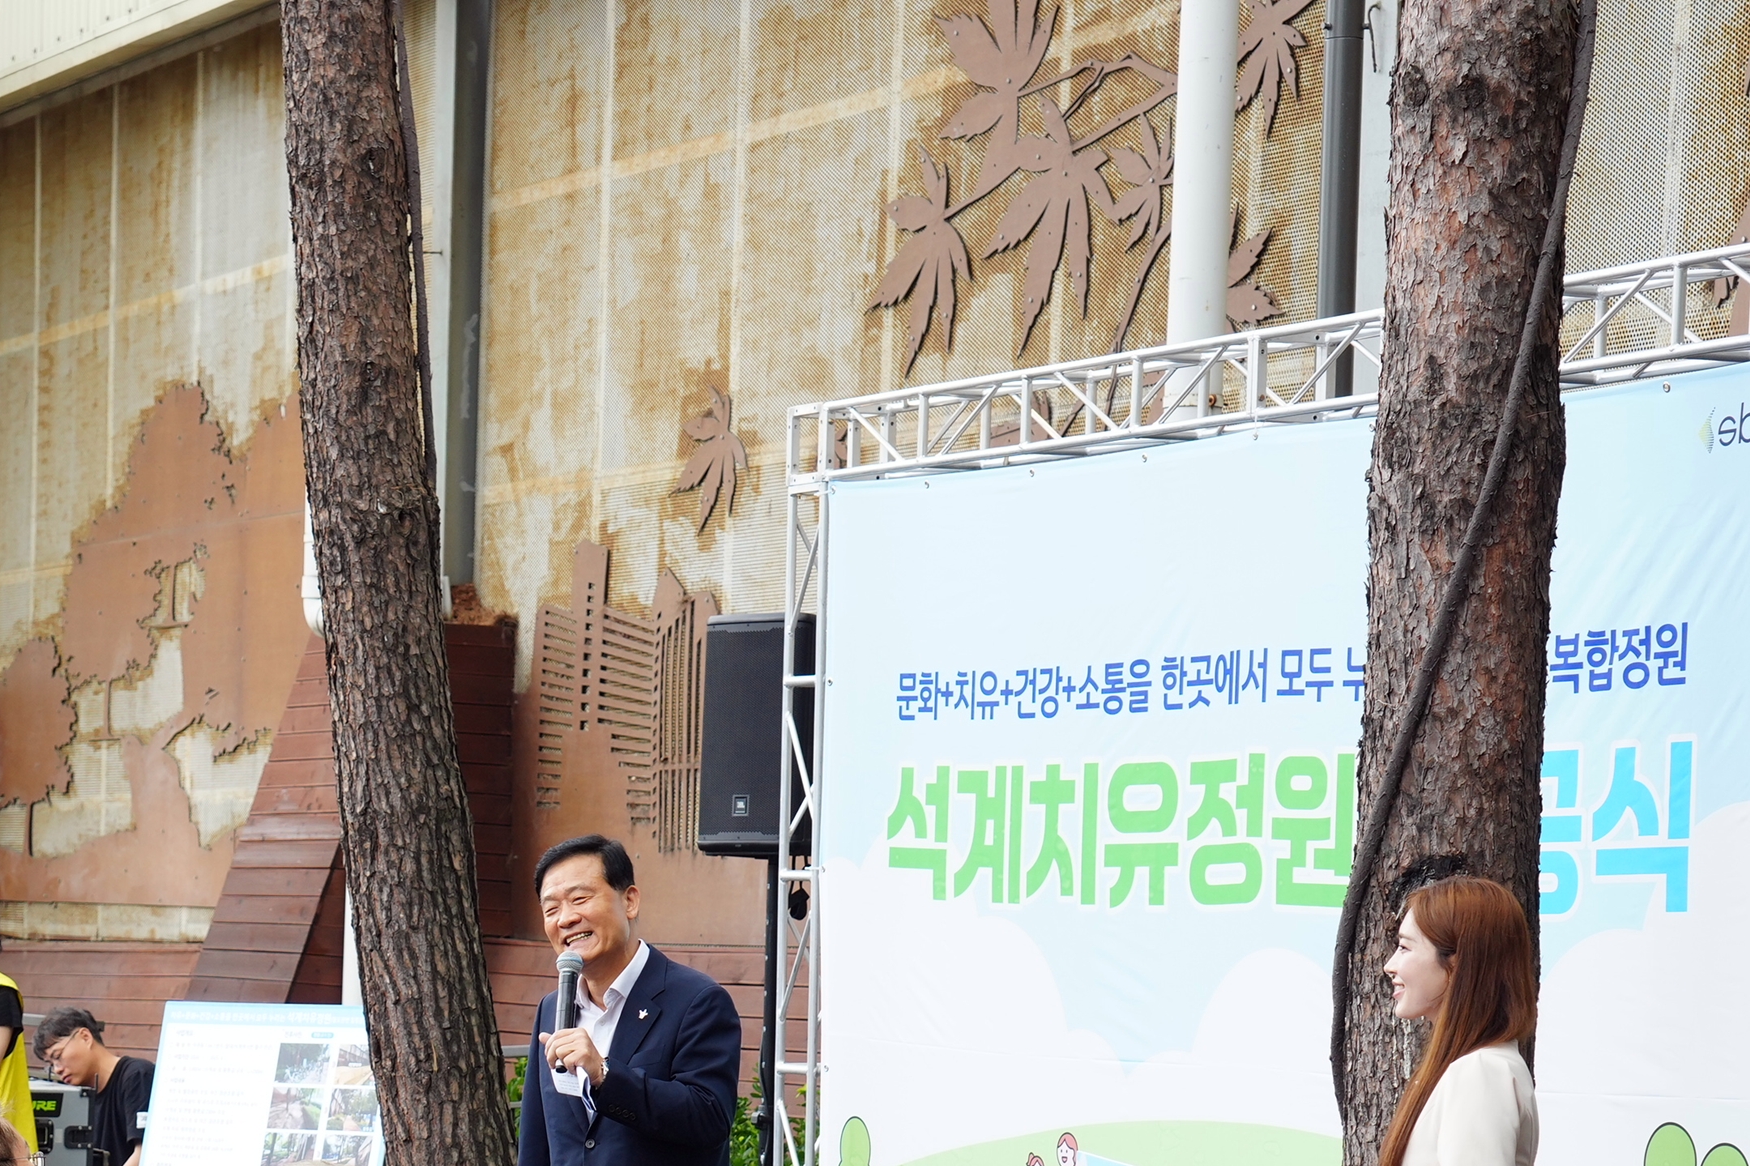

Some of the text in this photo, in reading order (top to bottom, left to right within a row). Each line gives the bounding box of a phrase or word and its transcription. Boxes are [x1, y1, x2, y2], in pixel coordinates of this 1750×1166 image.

[1718, 402, 1750, 446] sb
[896, 621, 1688, 720] 문화+치유+건강+소통을 한곳에서 모두 누 복합정원
[887, 752, 1357, 910] 석계치유정원
